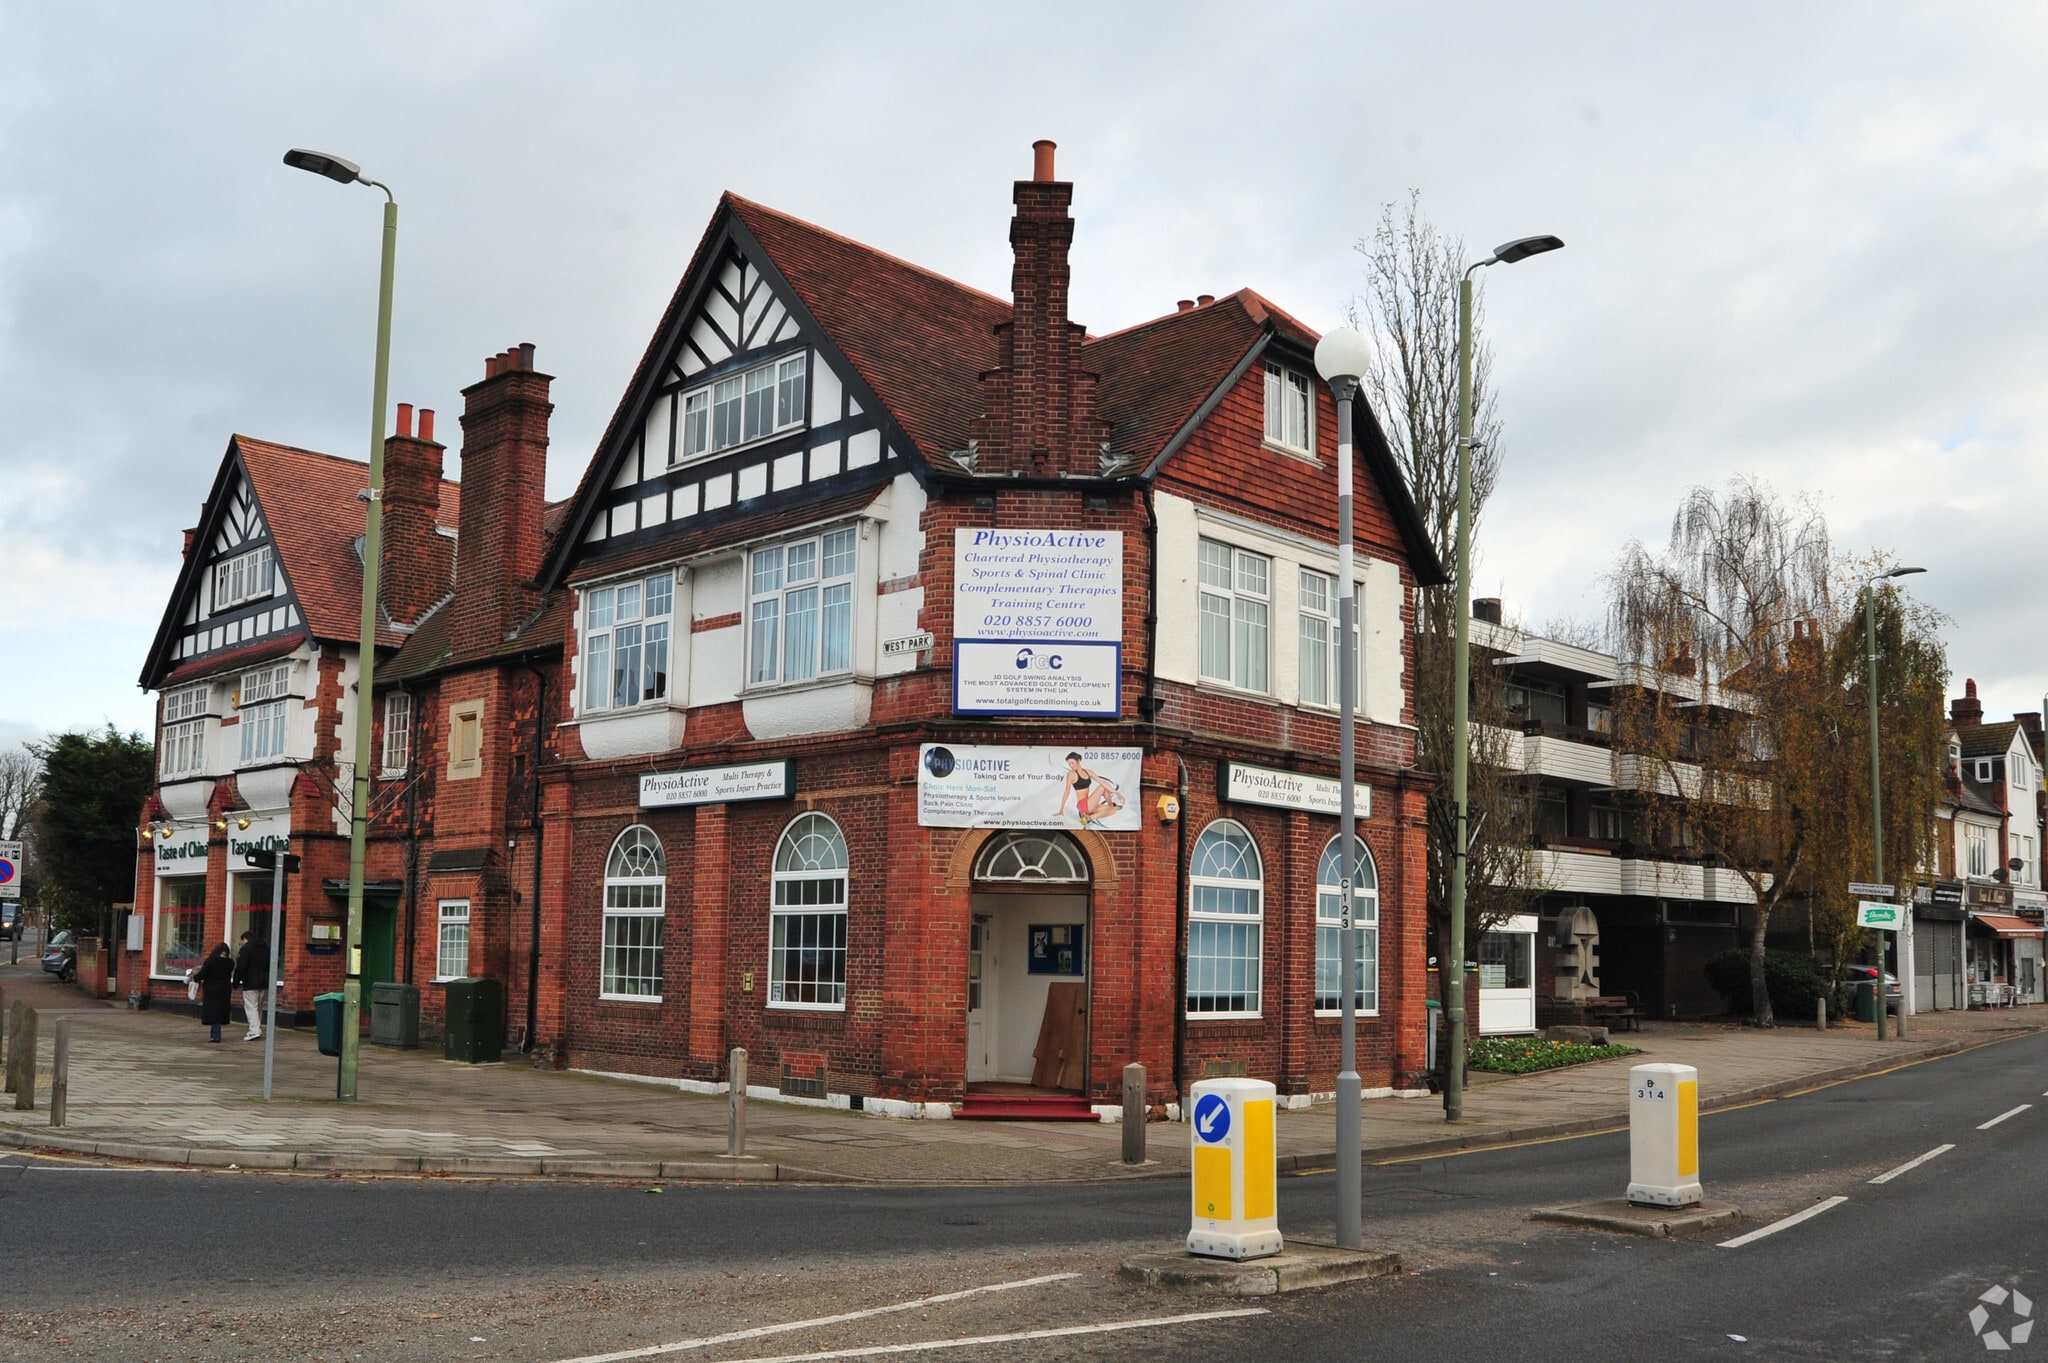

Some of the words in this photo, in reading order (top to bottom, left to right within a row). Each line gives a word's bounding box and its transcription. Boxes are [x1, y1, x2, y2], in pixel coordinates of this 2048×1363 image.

[972, 531, 1106, 549] PhysioActive
[964, 553, 1024, 563] Chartered
[1028, 554, 1113, 567] Physiotherapy
[971, 567, 1010, 578] Sports
[1015, 569, 1024, 578] &
[1028, 568, 1068, 580] Spinal
[1071, 569, 1106, 579] Clinic
[959, 583, 1054, 595] Complementary
[1059, 584, 1117, 596] Therapies
[991, 599, 1042, 610] Training
[1046, 600, 1085, 609] Centre
[984, 615, 1011, 626] 020
[1016, 616, 1051, 627] 8857
[1056, 617, 1092, 628] 6000
[977, 628, 1098, 638] www.physioactive.com
[884, 641, 905, 652] WEST
[908, 636, 929, 648] PARK
[975, 698, 1101, 707] www.totalgolfconditioning.co.uk
[934, 757, 1010, 771] PHYSIOACTIVE
[643, 775, 709, 794] PhysioActive
[722, 772, 739, 781] Multi
[740, 770, 766, 780] Therapy
[766, 769, 772, 777] &
[1233, 768, 1303, 792] PhysioActive
[1316, 784, 1330, 792] Multi
[666, 791, 677, 800] 020
[678, 790, 692, 799] 8857
[693, 790, 708, 799] 6000
[715, 785, 735, 795] Sports
[736, 783, 755, 794] Injury
[756, 781, 782, 791] Practice
[923, 792, 967, 801] Physiotherapy
[1257, 791, 1270, 799] 020
[1270, 792, 1285, 801] 8857
[1287, 793, 1302, 803] 6000
[1308, 795, 1326, 805] Sports
[158, 845, 177, 860] Taste
[179, 842, 187, 858] of
[188, 841, 208, 857] China
[230, 838, 253, 855] Taste
[255, 836, 264, 850] of
